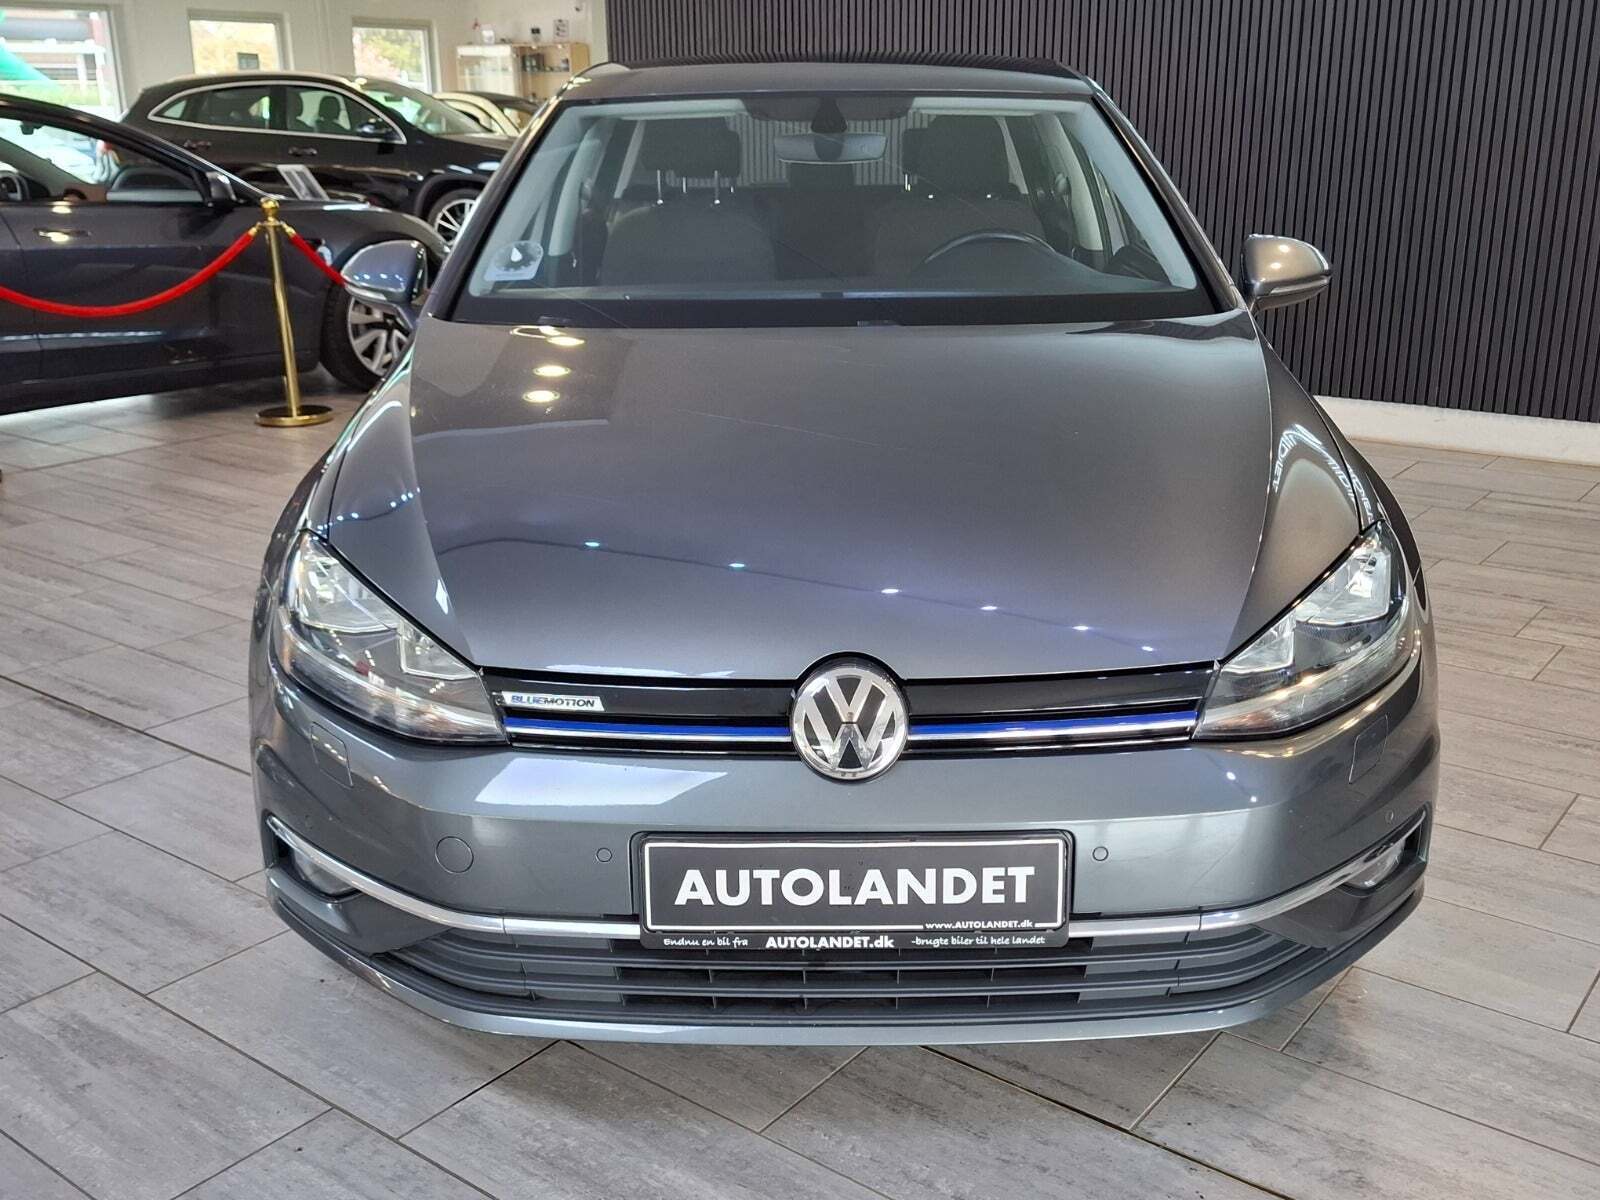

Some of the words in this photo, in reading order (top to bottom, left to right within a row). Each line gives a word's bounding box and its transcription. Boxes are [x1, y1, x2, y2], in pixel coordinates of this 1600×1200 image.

[511, 694, 595, 708] BLUEMOTION
[673, 866, 1035, 906] AUTOLANDET
[925, 920, 1034, 929] www.AUTOLANDET.dk
[663, 937, 700, 946] Endnu
[702, 938, 715, 947] en
[717, 936, 730, 946] bil
[732, 936, 748, 948] fra
[765, 935, 895, 949] AUTOLANDET.dk
[951, 935, 974, 945] biler
[976, 935, 988, 945] til
[990, 936, 1010, 945] hele
[1012, 935, 1046, 945] landet
